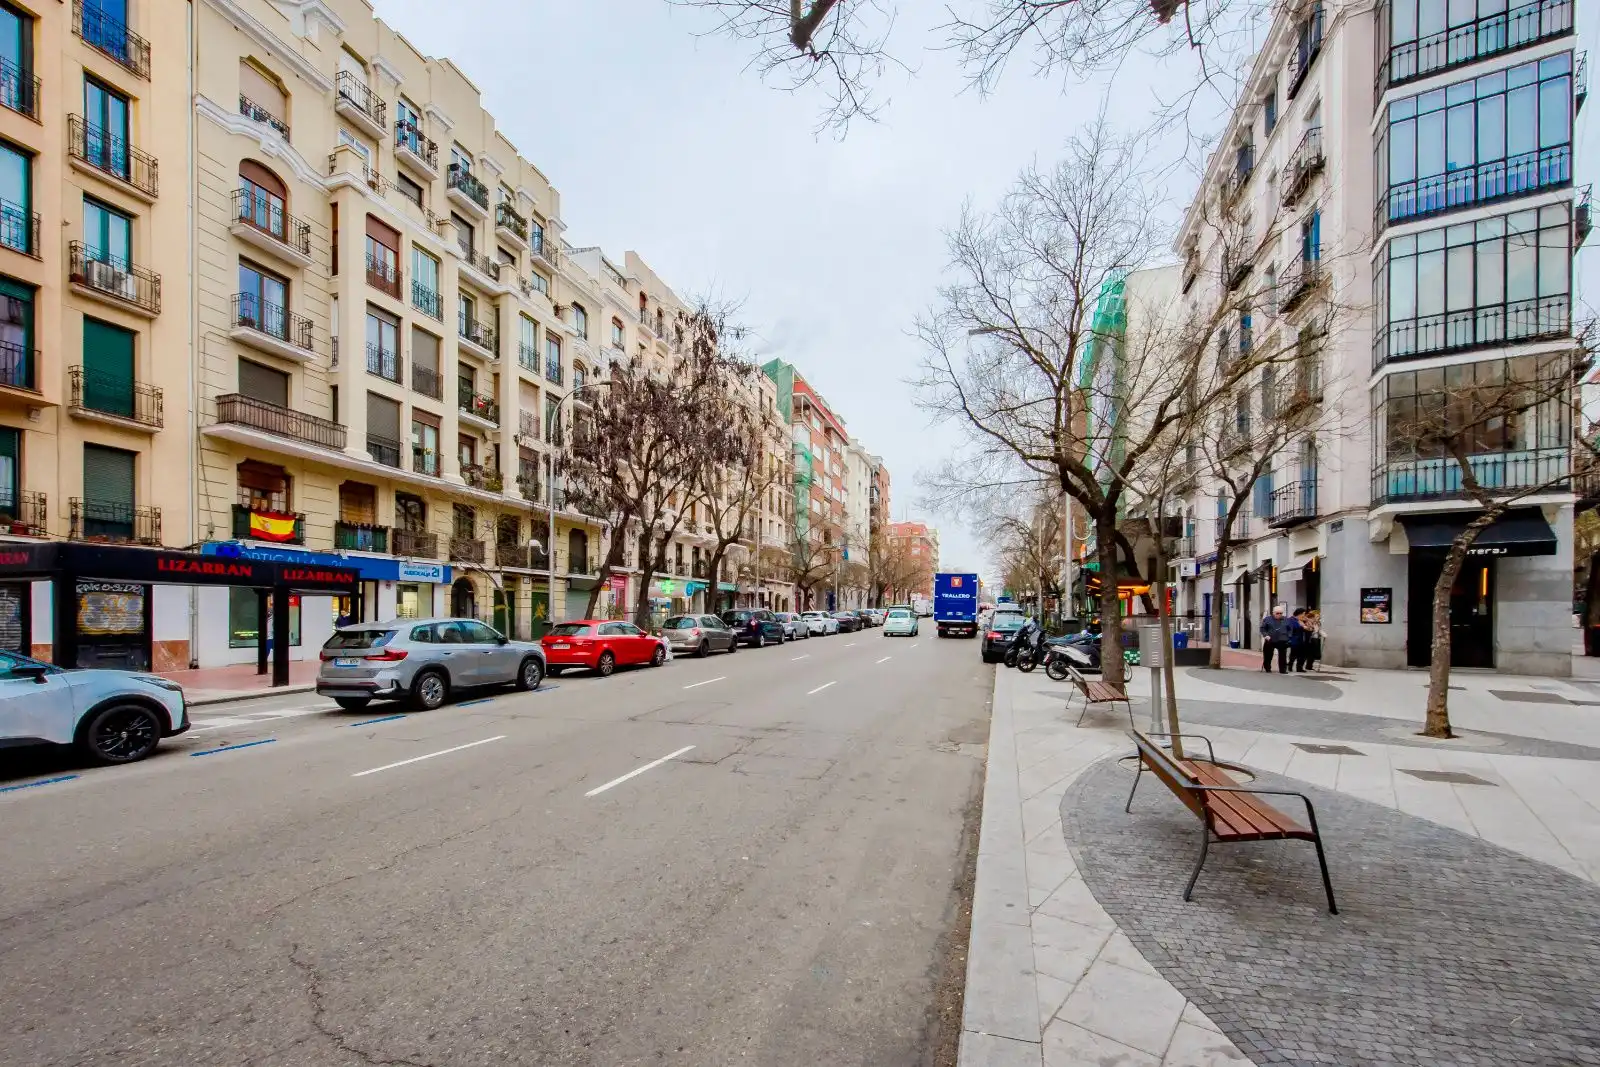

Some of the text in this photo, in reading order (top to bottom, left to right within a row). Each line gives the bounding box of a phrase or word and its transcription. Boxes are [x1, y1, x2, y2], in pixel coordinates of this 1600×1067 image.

[157, 559, 252, 577] LIZARRAN
[283, 568, 353, 583] LIZARRAN
[431, 566, 440, 578] 21
